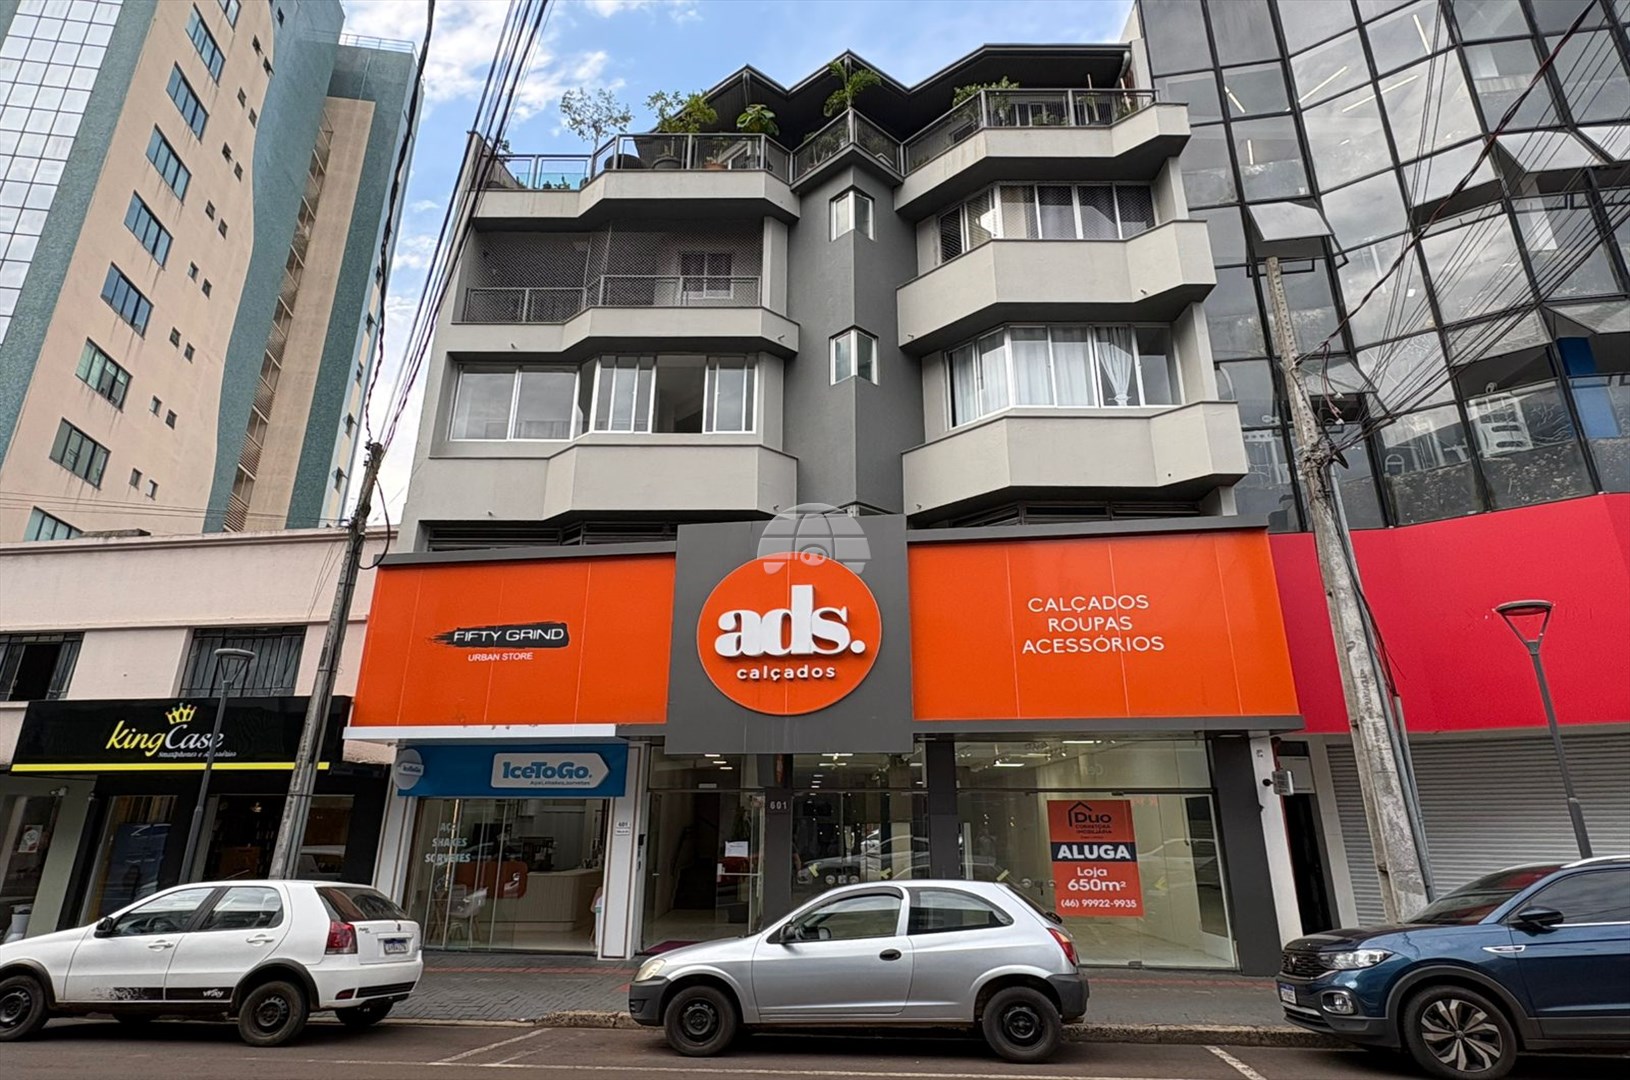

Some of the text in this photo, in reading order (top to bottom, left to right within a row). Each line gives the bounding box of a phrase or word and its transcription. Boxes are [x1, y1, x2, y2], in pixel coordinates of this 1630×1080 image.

[1027, 594, 1150, 614] CALÇADOS
[715, 584, 866, 657] ads.
[1047, 616, 1133, 633] ROUPAS
[453, 627, 564, 643] FIFTY GRIND
[1021, 635, 1166, 655] ACESSÓRIOS
[467, 651, 534, 662] URBAN STORE
[736, 664, 837, 682] calçados
[431, 837, 468, 848] SHAKES
[425, 853, 471, 863] SORVETES
[1057, 844, 1131, 860] ALUGA
[1077, 866, 1108, 878] Loja
[1061, 898, 1137, 909] (46) 99922-9935
